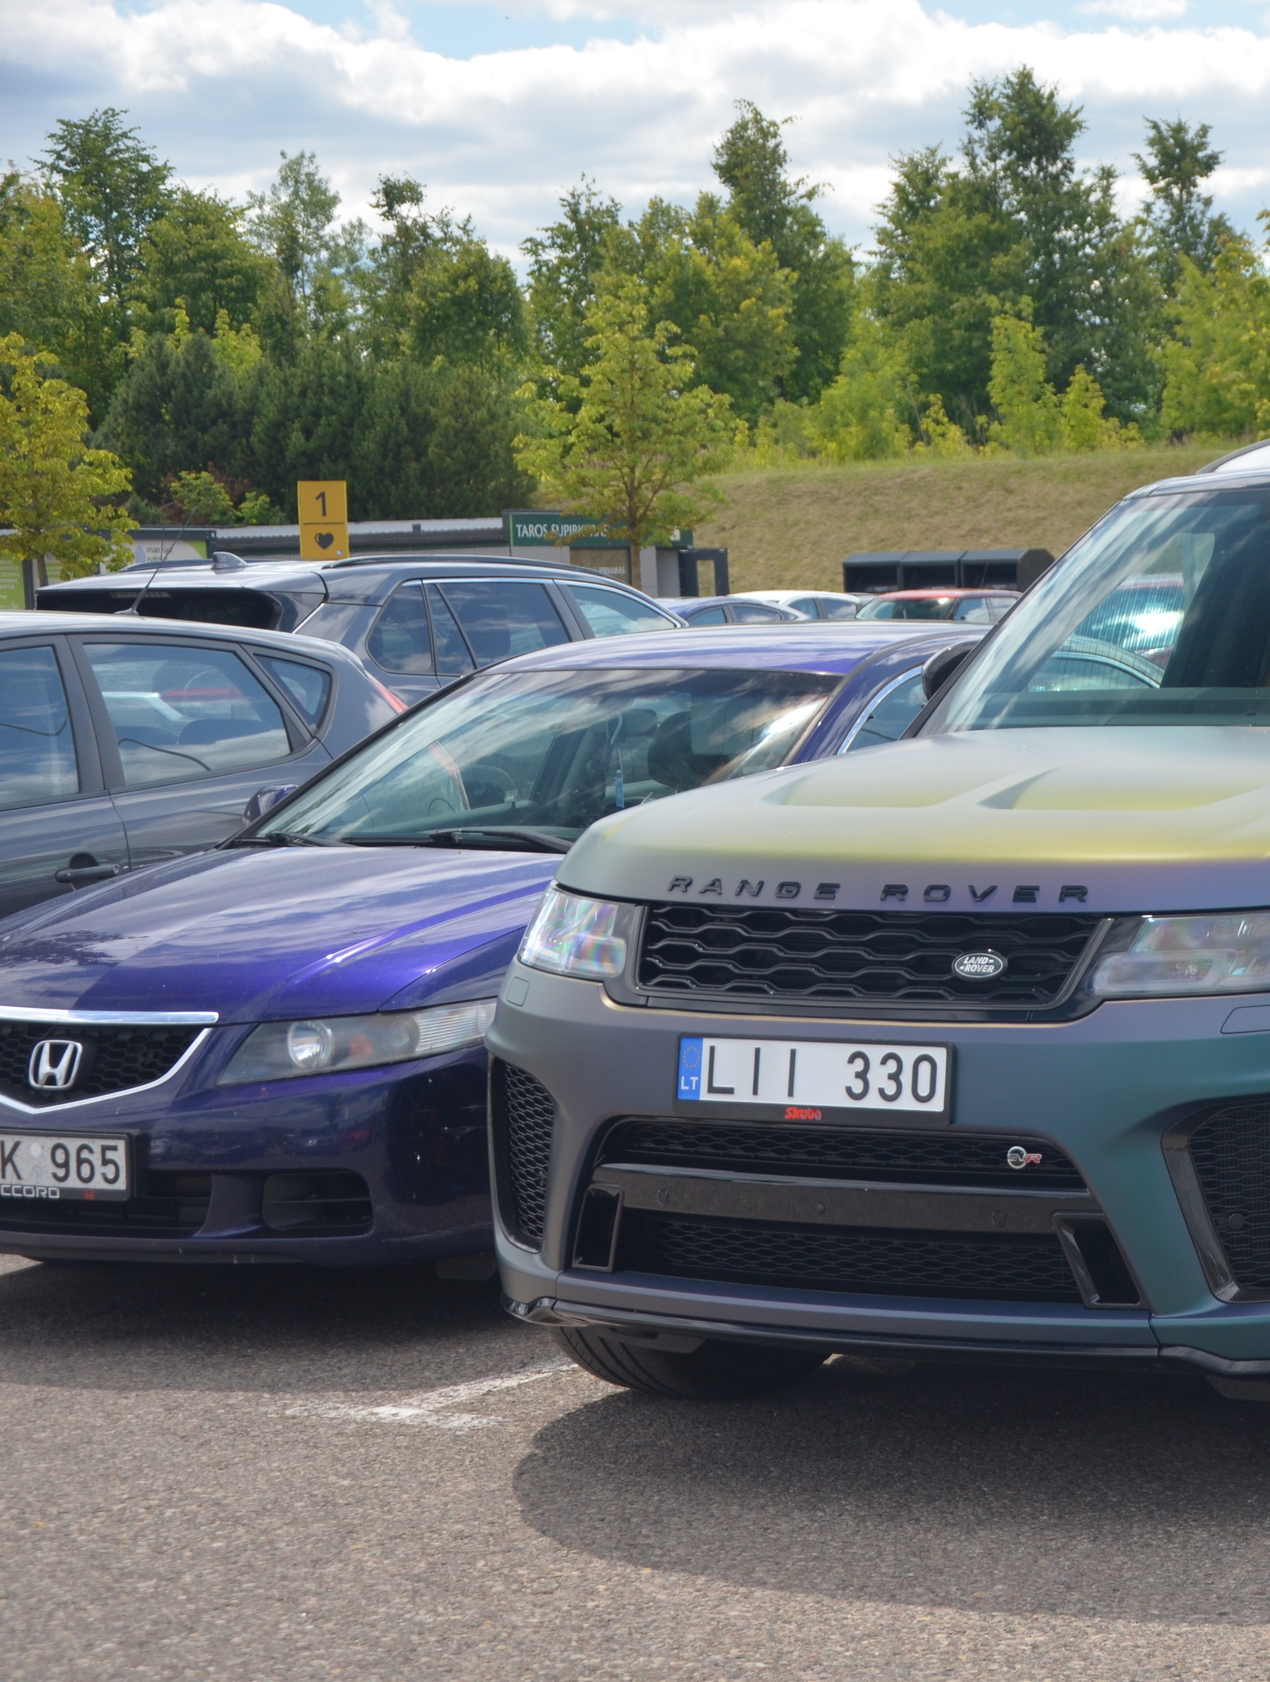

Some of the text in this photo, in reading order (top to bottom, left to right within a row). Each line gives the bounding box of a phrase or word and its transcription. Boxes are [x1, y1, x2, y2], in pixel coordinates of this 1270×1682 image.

[314, 491, 327, 517] 1
[516, 524, 548, 538] TAROS
[667, 875, 1089, 903] RANGE ROVER
[680, 1076, 699, 1090] LT
[707, 1045, 938, 1103] LII 330
[0, 1140, 120, 1184] K 965
